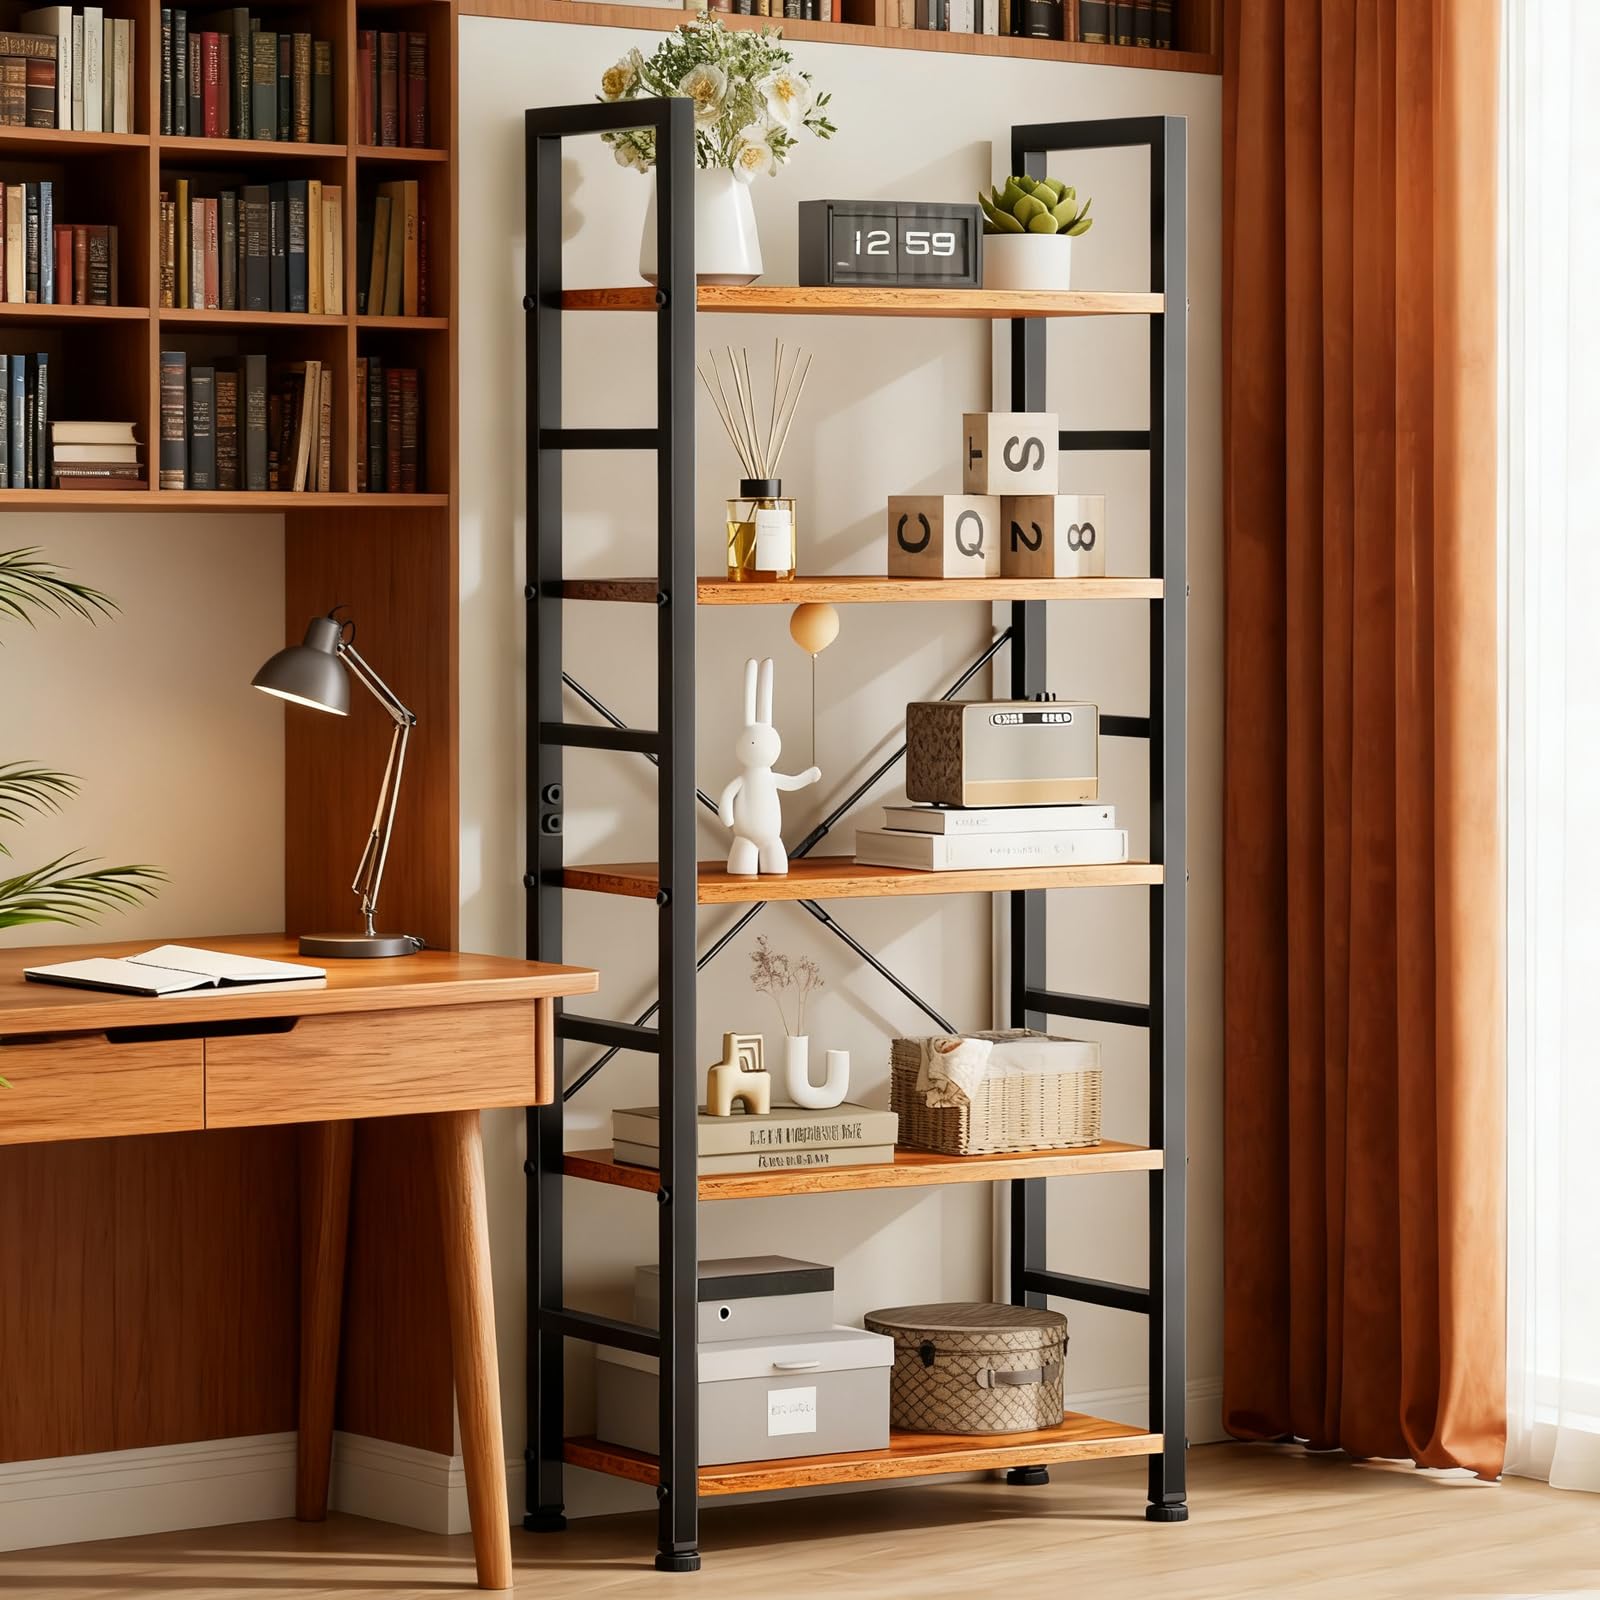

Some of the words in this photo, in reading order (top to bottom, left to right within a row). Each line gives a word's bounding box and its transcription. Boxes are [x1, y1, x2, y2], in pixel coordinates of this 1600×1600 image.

[855, 230, 891, 255] 12
[905, 231, 955, 256] 59
[1003, 435, 1045, 473] S
[896, 512, 931, 554] C
[955, 509, 985, 560] Q
[1010, 520, 1043, 553] 2
[1067, 522, 1096, 552] 8
